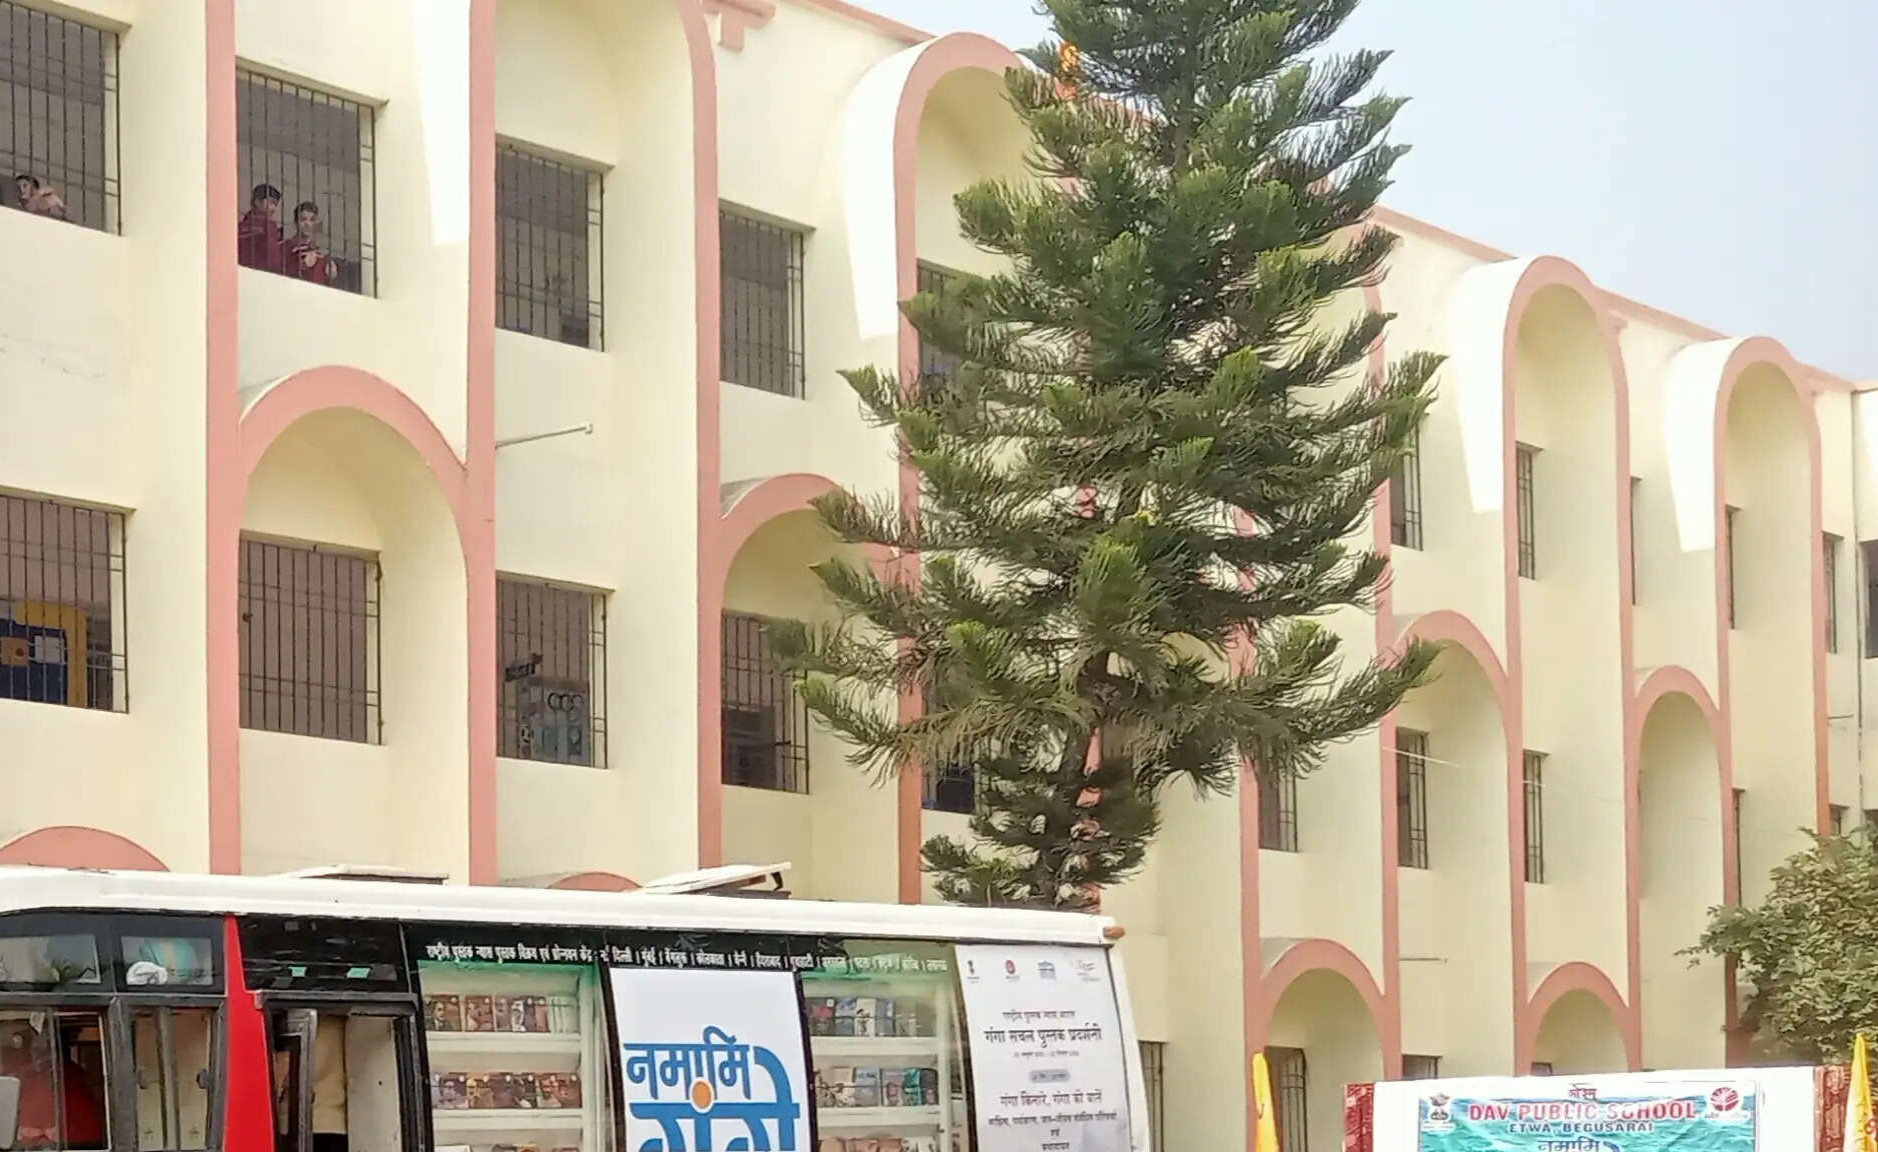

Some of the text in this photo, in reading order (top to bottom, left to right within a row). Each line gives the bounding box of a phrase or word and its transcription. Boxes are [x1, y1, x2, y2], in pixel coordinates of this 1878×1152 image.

[984, 1026, 1005, 1043] गंगा
[1037, 1028, 1065, 1048] पुस्तक
[623, 1026, 751, 1100] नमामि
[1470, 1104, 1510, 1120] DAV
[1519, 1103, 1597, 1120] PUBLIC
[1606, 1101, 1696, 1119] SCHOOL
[1563, 1122, 1653, 1133] BEGUSARAI
